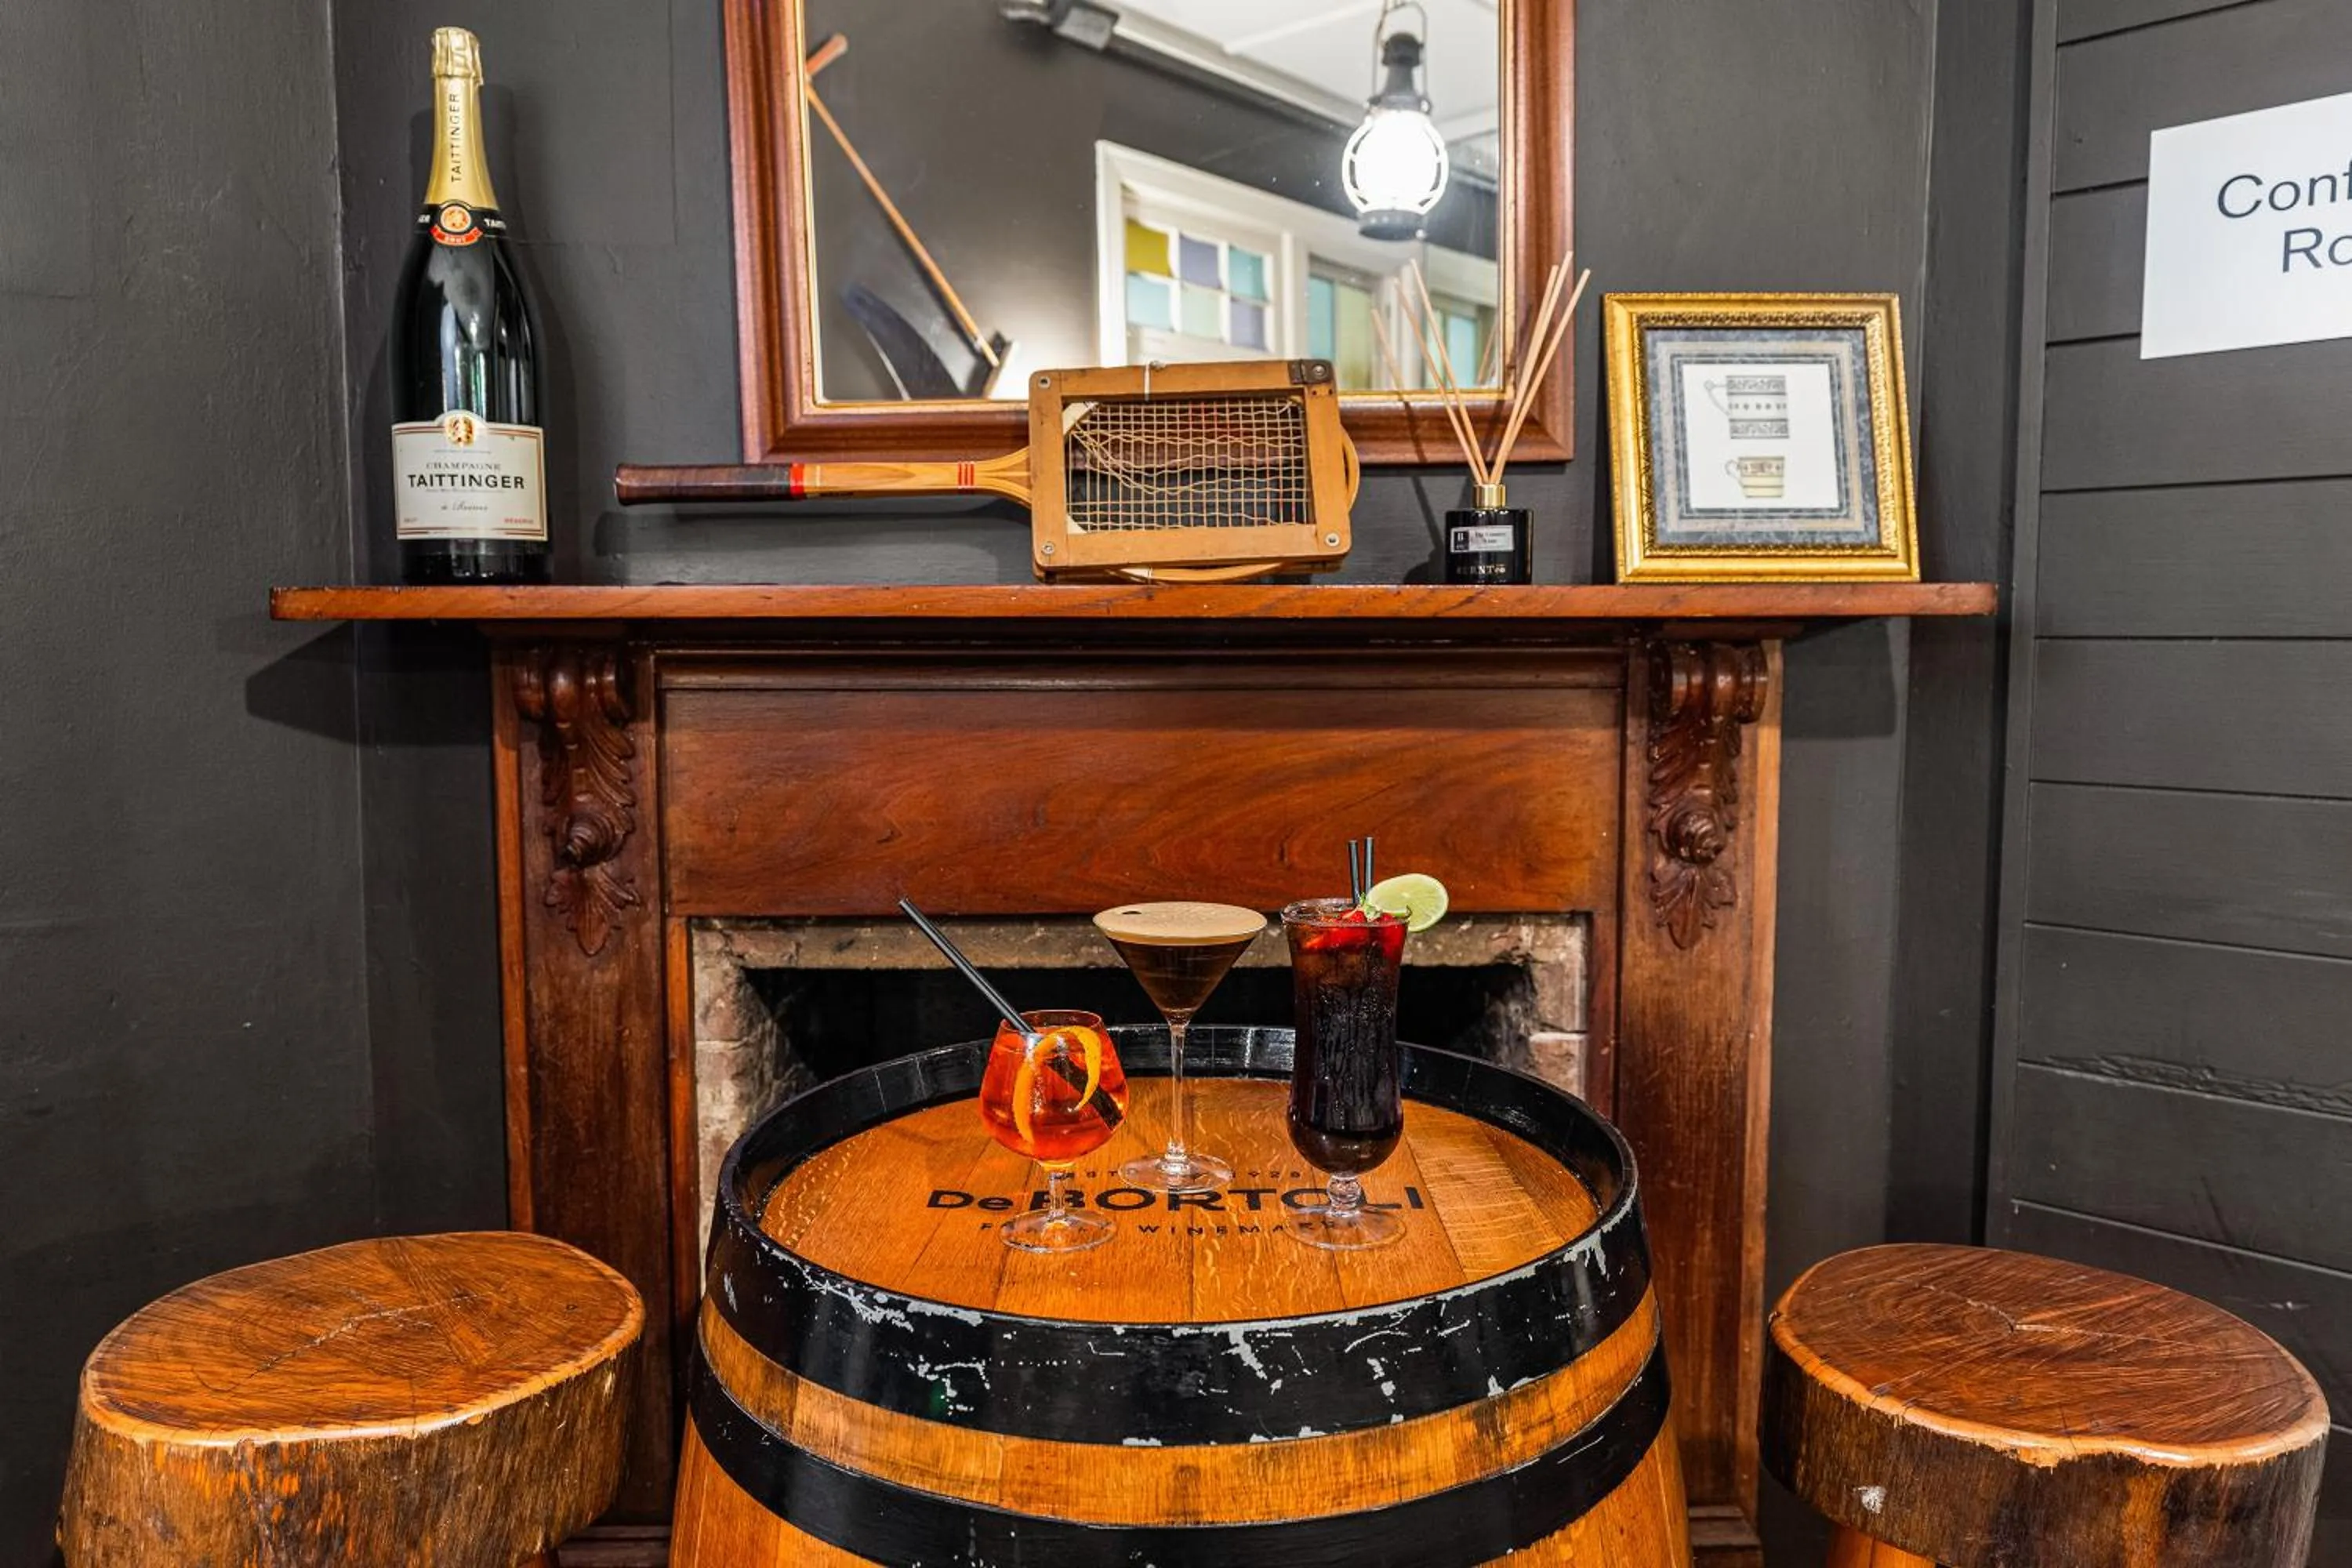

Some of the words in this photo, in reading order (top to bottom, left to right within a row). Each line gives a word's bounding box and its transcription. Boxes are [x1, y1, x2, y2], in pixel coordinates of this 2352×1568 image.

[449, 93, 462, 183] TAITTINGER
[426, 462, 502, 471] CHAMPAGNE
[407, 474, 526, 490] TAITTINGER
[926, 1189, 1014, 1211] De
